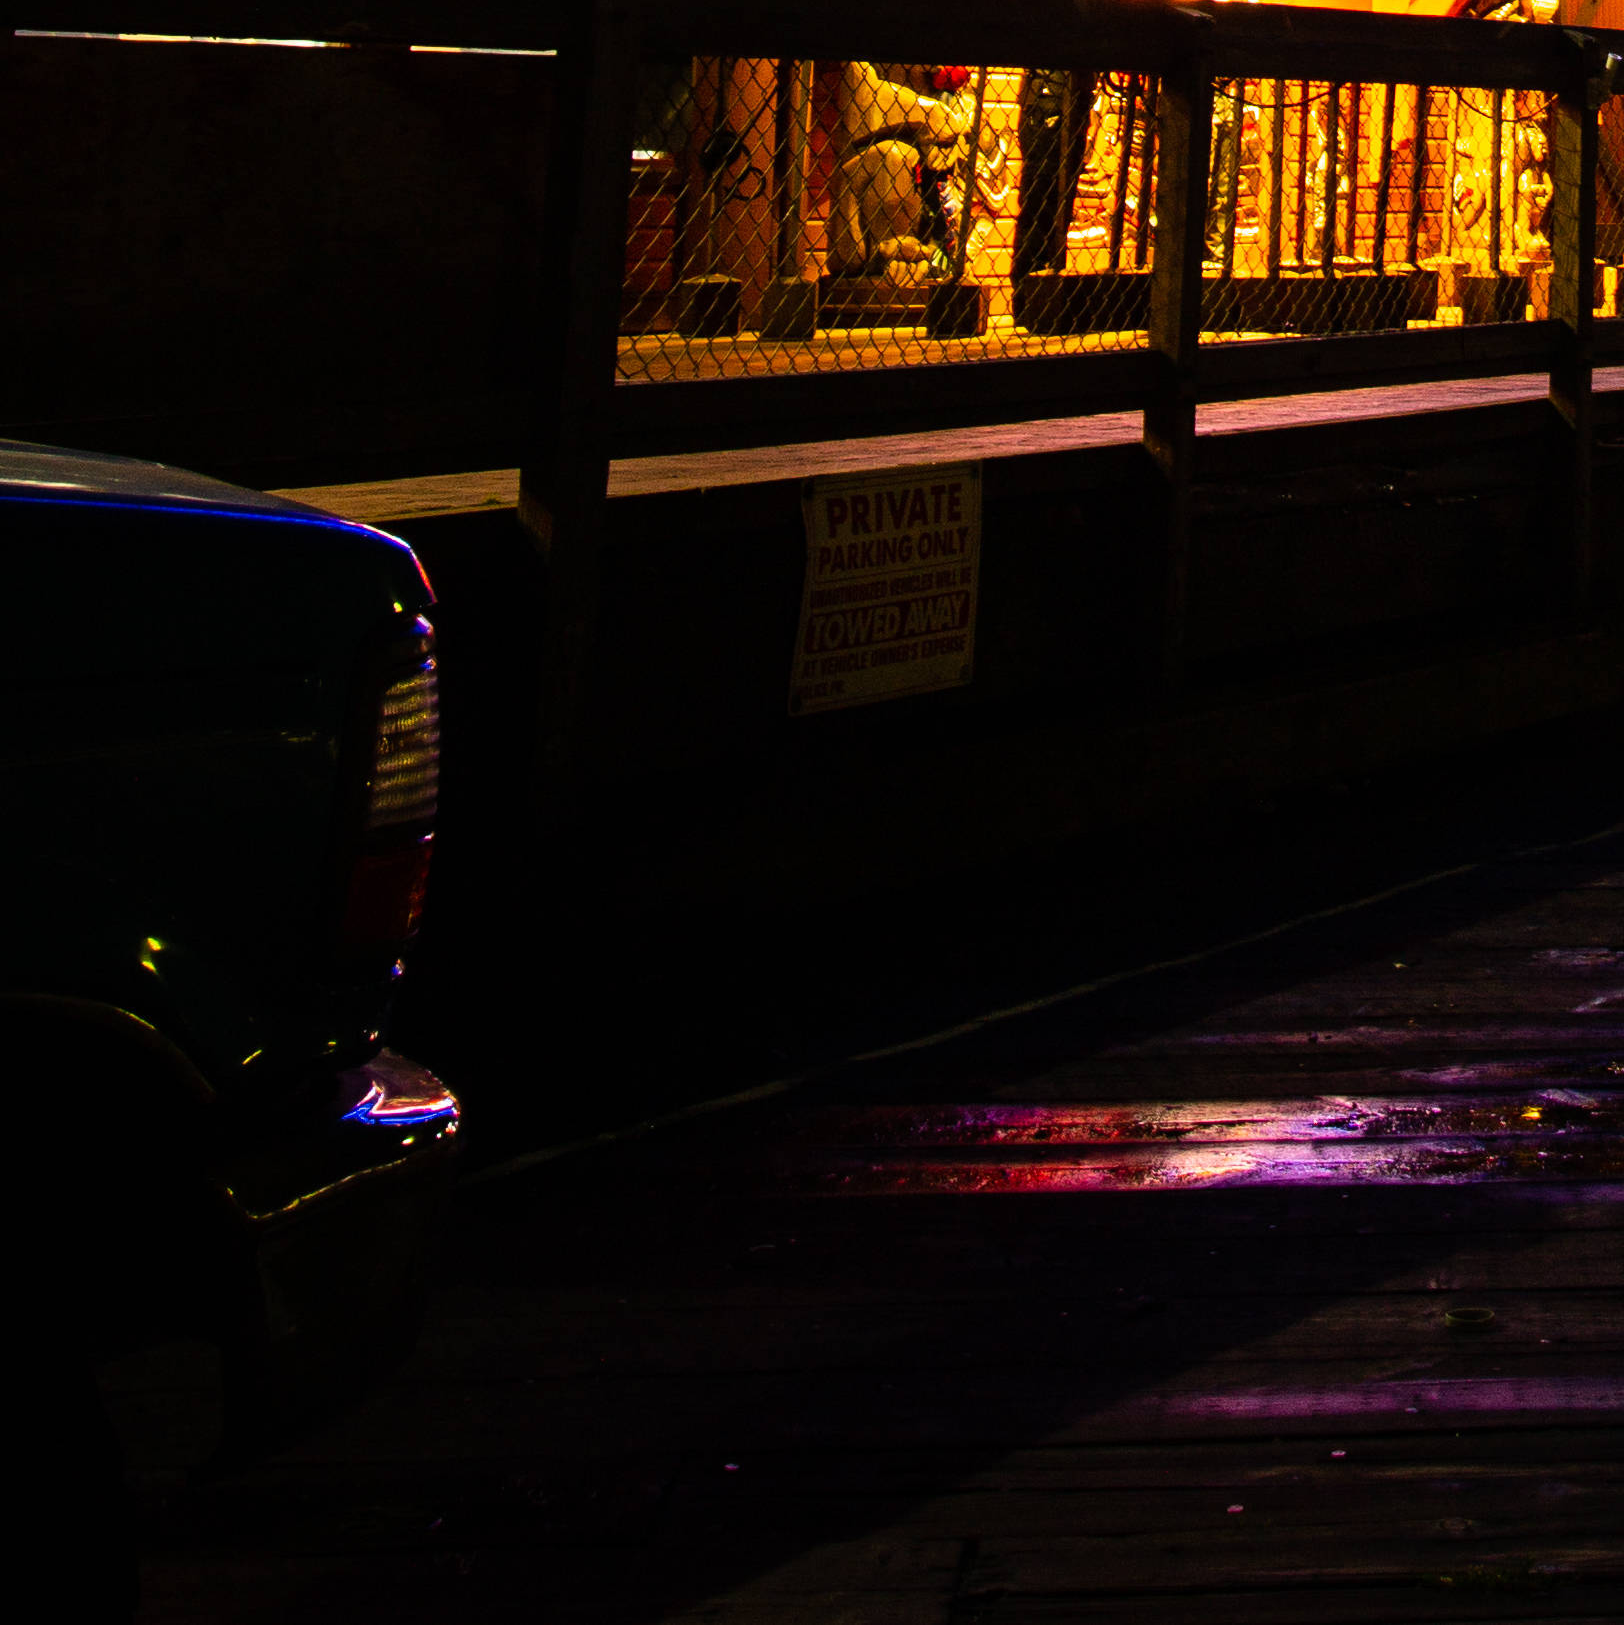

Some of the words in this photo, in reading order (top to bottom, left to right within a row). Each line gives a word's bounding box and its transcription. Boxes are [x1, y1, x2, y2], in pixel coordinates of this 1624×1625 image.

[826, 483, 963, 539] PRIVATE
[818, 535, 914, 575] PARKING
[917, 527, 969, 561] ONLY
[812, 605, 901, 651] TOWED
[904, 592, 968, 635] AWAY
